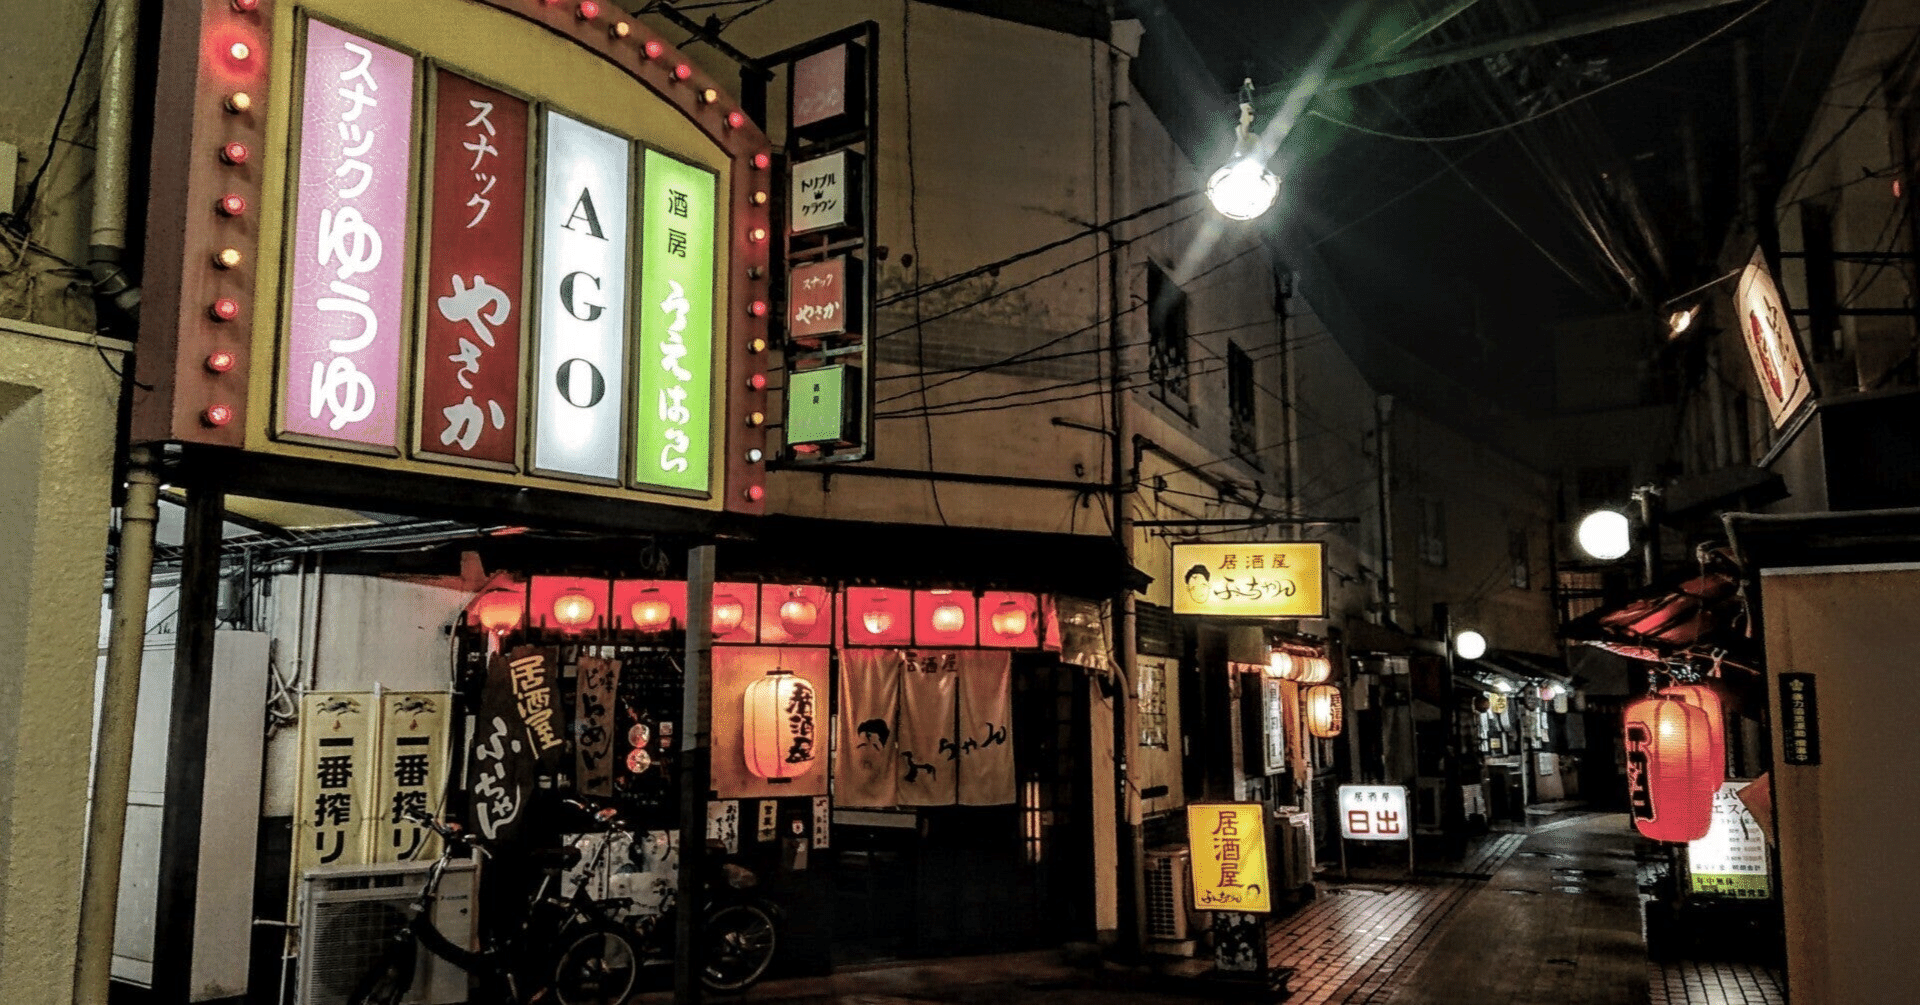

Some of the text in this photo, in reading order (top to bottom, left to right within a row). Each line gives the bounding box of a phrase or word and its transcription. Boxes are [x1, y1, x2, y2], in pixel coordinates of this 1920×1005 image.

[802, 199, 838, 217] クラウン
[437, 99, 511, 452] スナック やさか
[555, 186, 609, 409] AGO
[795, 301, 839, 324] やさか
[803, 273, 833, 290] スナック
[658, 188, 690, 475] 酒房 うえはら
[1218, 553, 1290, 570] 居酒屋
[509, 654, 563, 760] 居酒屋
[785, 682, 816, 764] 居酒屋
[314, 736, 354, 864] 一番搾り
[391, 736, 430, 861] 一番搾り
[1348, 810, 1400, 833] 日出
[1211, 810, 1243, 888] 居酒屋
